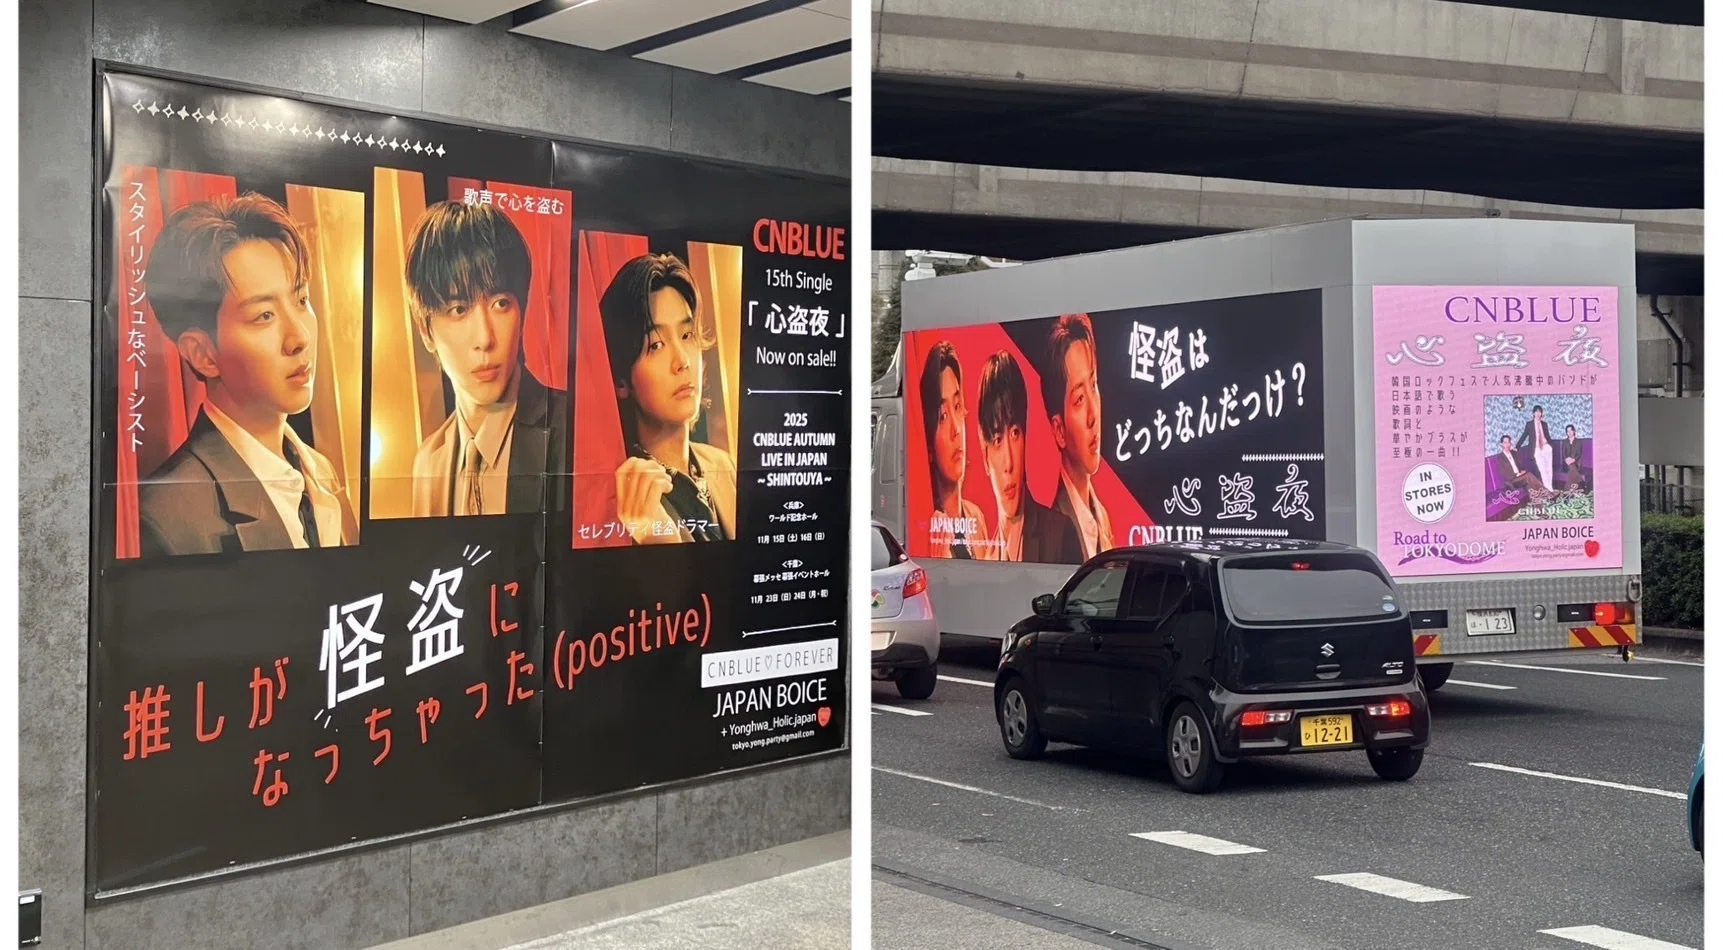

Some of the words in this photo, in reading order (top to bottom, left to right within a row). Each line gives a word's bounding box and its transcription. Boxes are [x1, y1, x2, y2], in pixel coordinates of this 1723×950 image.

[464, 188, 565, 215] 歌声で心を盗む
[753, 218, 845, 260] CNBLUE
[765, 269, 792, 288] 15th
[796, 271, 833, 294] Single
[127, 181, 147, 453] スタイリッシュなベーシスト
[748, 301, 845, 338] 「心盗夜」
[1445, 297, 1602, 323] CNBLUE
[756, 346, 785, 365] Now
[788, 351, 804, 366] on
[807, 349, 837, 367] sale!!
[1128, 321, 1210, 389] 怪盗は
[1385, 324, 1609, 369] 心盗夜
[1392, 390, 1455, 401] 日本語で歌う
[783, 412, 808, 427] 2025
[1116, 362, 1306, 461] どっちなんだっけ？
[1392, 404, 1456, 416] 映画のような
[1392, 419, 1421, 430] 歌詞と
[753, 432, 793, 447] CNBLUE
[793, 432, 836, 446] AUTUMN
[761, 452, 783, 467] LIVE
[784, 452, 796, 466] IN
[796, 452, 828, 466] JAPAN
[766, 471, 824, 487] SHINTOUYA
[1419, 471, 1432, 482] IN
[1164, 463, 1314, 521] 心盗夜
[1405, 484, 1452, 501] STORES
[1417, 501, 1445, 515] NOW
[578, 519, 719, 540] セレブリティ怪盗ドラマー
[929, 517, 954, 533] JAPAN
[954, 517, 978, 534] BOICE
[1522, 527, 1559, 540] JAPAN
[1562, 526, 1594, 539] BOICE
[1394, 530, 1430, 546] Road
[1433, 533, 1448, 545] to
[1403, 541, 1506, 559] TOKYODOME
[707, 656, 761, 678] CNBLUE
[776, 647, 833, 669] FOREVER
[253, 650, 535, 807] なっちゃった
[553, 593, 711, 690] (positive)
[712, 685, 772, 718] JAPAN
[776, 678, 827, 708] BOICE
[729, 712, 817, 736] Yonghwa_Holic.japan
[1314, 726, 1348, 743] 12-21
[731, 729, 815, 751] tokyo.yong.party@gmail.com
